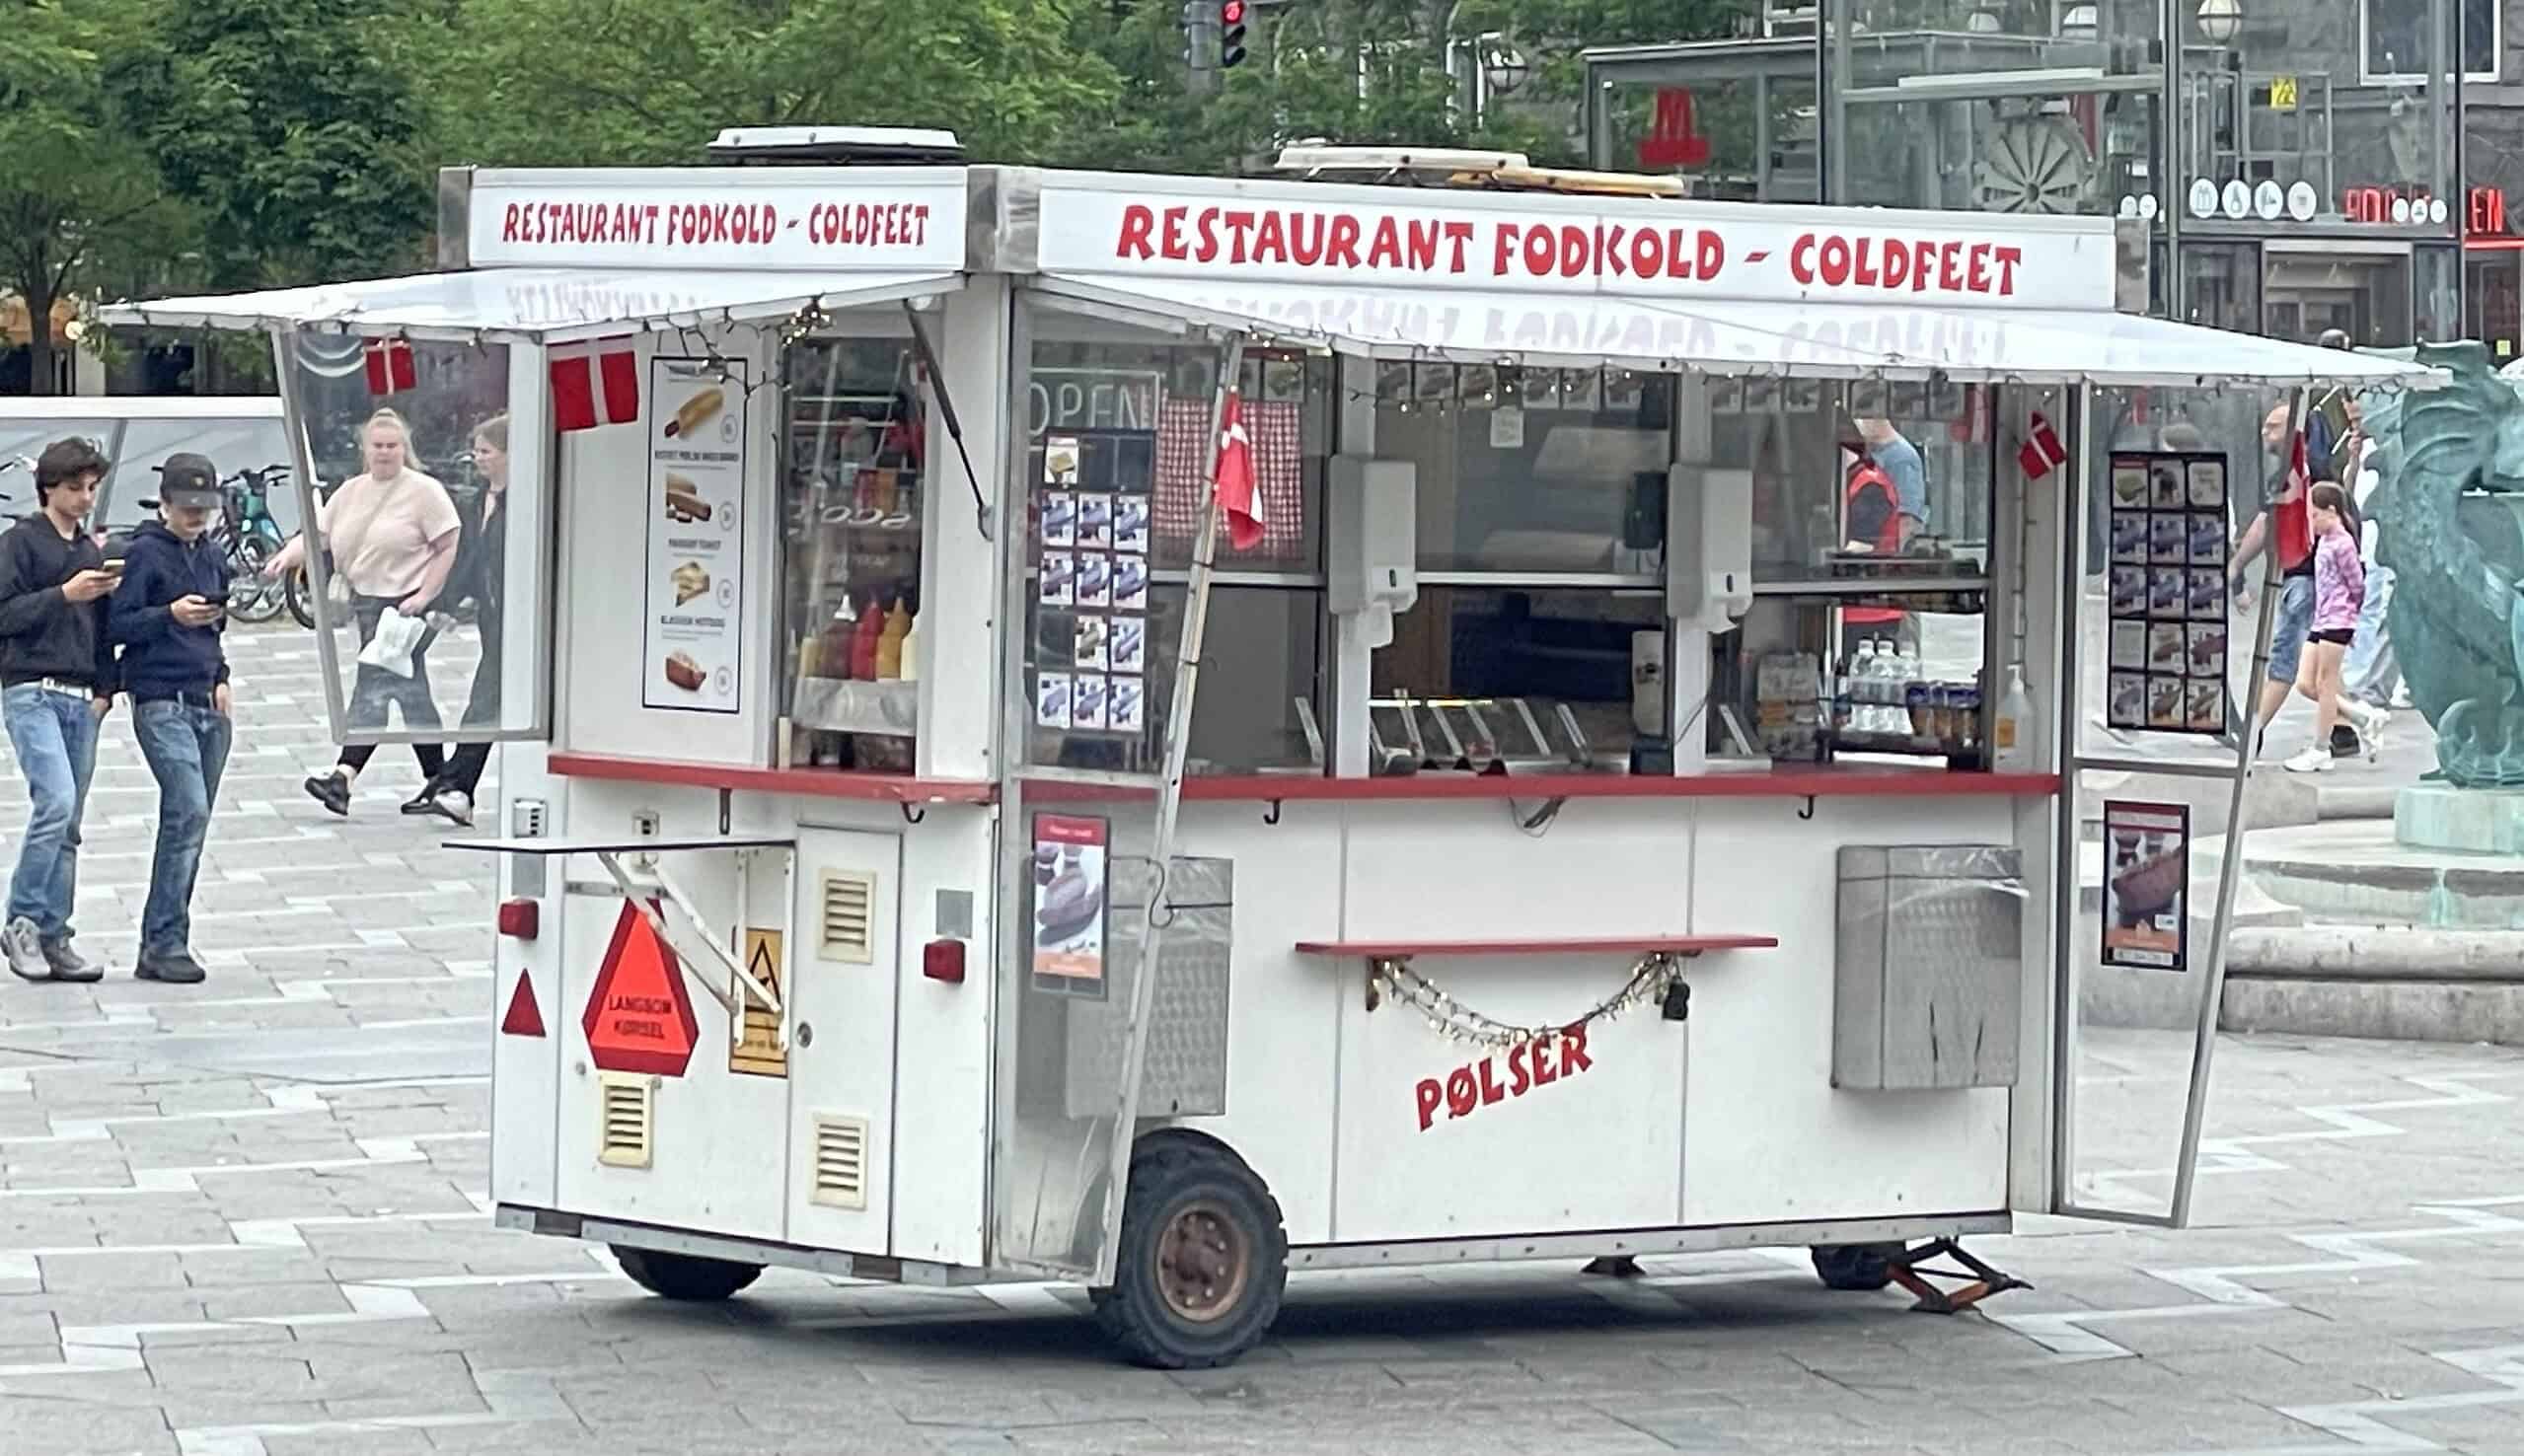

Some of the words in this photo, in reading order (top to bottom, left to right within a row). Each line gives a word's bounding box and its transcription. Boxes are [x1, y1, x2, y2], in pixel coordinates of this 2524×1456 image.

[502, 202, 659, 245] RESTAURANT
[666, 203, 777, 246] FODKOLD
[808, 202, 929, 246] COLDFEET
[1116, 204, 1475, 274] RESTAURANT
[1493, 222, 1726, 282] FODKOLD
[1790, 233, 2022, 297] COLDFEET
[1415, 1023, 1593, 1131] PØLSER
